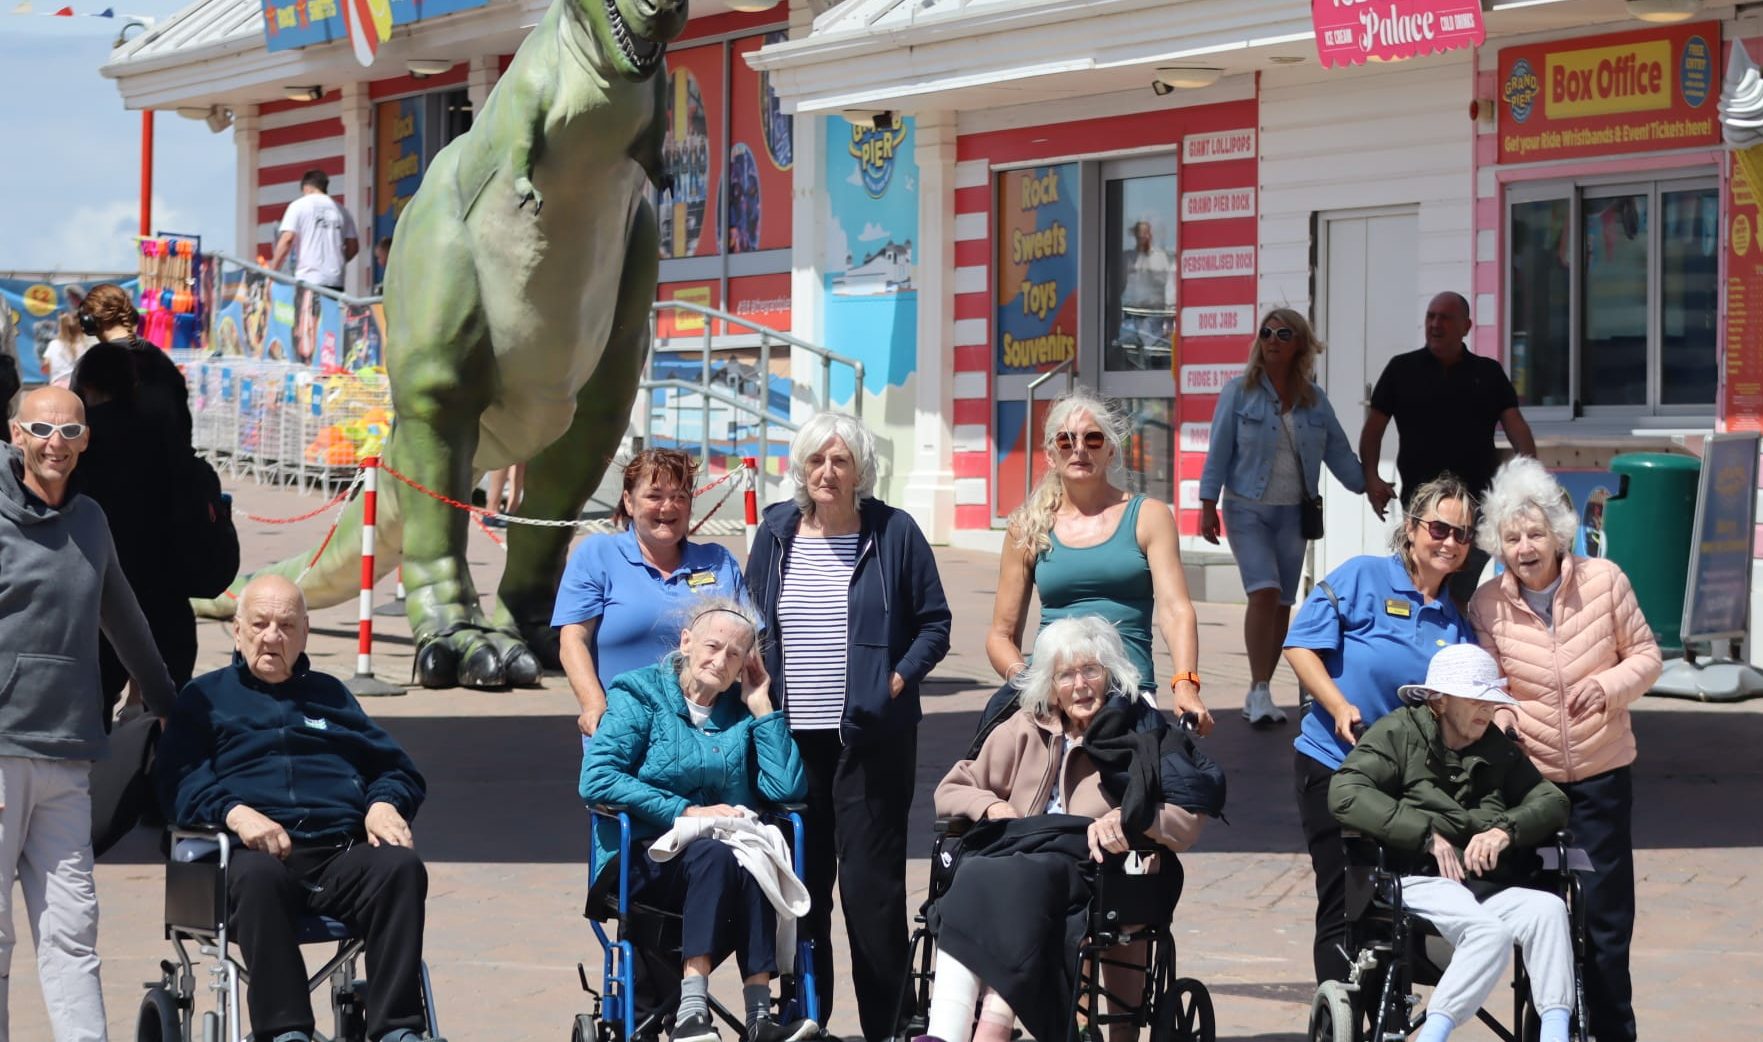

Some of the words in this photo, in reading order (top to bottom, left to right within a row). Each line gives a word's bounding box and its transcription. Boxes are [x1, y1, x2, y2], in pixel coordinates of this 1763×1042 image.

[1359, 4, 1434, 52] Palace
[1440, 16, 1454, 31] COLD
[1455, 13, 1475, 30] DRINKS
[1324, 30, 1335, 46] ICE
[1334, 28, 1352, 45] CREAM
[1504, 73, 1537, 95] GRAND
[1552, 64, 1593, 103] Box
[1597, 52, 1662, 99] Office
[1511, 89, 1532, 109] PIER
[1188, 139, 1210, 157] GIANT
[1211, 135, 1251, 155] LOLLIPOPS
[1504, 135, 1519, 152] Get
[1520, 135, 1540, 155] your
[1541, 131, 1560, 149] Ride
[1561, 127, 1613, 147] Wristbands
[1615, 125, 1621, 143] &
[1622, 123, 1648, 142] Event
[1650, 120, 1684, 139] Tickets
[1685, 117, 1712, 137] here!
[862, 131, 893, 170] PIER
[1021, 172, 1059, 211] Rock
[1188, 195, 1212, 214] GRAND
[1213, 193, 1229, 213] PIER
[1231, 192, 1250, 211] ROCK
[1013, 221, 1067, 264] Sweets
[1183, 253, 1234, 273] PERSONALISED
[1235, 252, 1253, 270] ROCK
[1021, 279, 1057, 321] Toys
[1198, 312, 1217, 330] ROCK
[1219, 311, 1238, 329] JARS
[1003, 326, 1075, 368] Souvenirs
[1187, 370, 1210, 388] FUDGE
